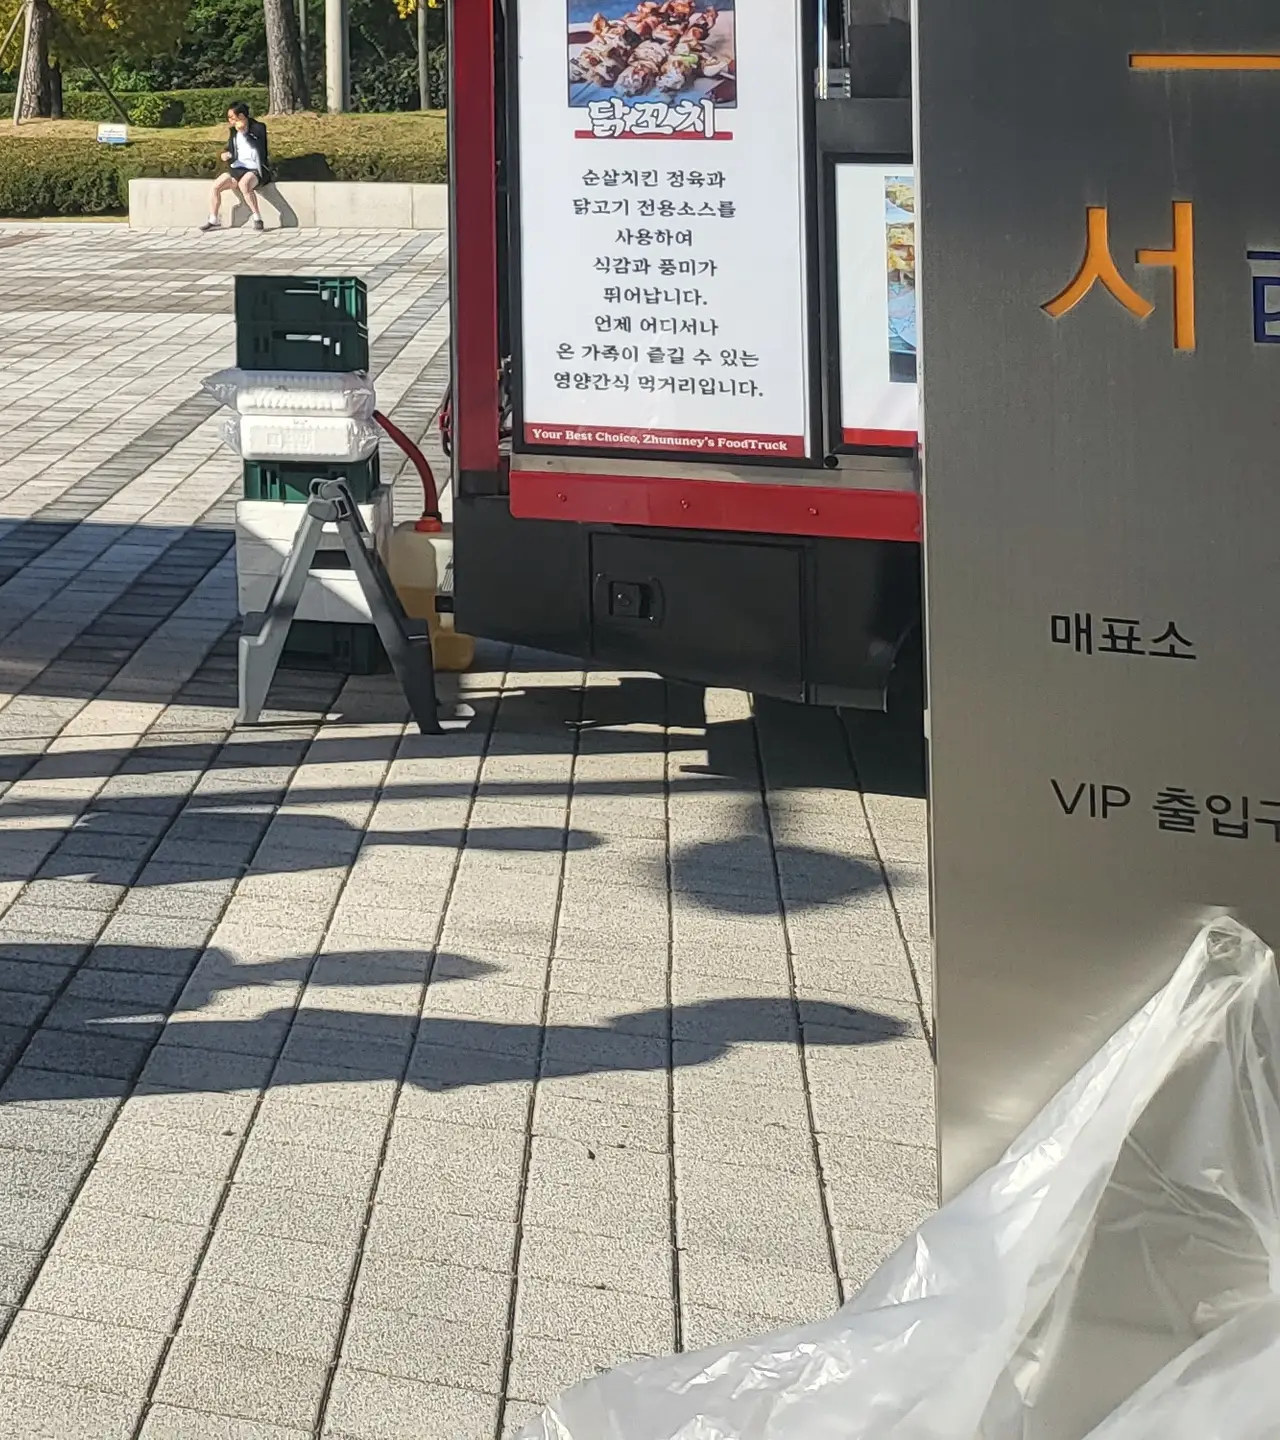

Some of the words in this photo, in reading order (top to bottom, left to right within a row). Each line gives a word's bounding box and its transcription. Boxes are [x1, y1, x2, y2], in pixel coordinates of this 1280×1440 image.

[588, 96, 716, 138] 닭꼬치
[582, 169, 658, 188] 순살치킨
[666, 170, 726, 188] 정육과
[572, 197, 630, 216] 닭고기
[637, 200, 736, 218] 전용소스를
[615, 228, 693, 247] 사용하여
[593, 256, 651, 275] 식감과
[658, 258, 717, 277] 풍미가
[1040, 200, 1196, 349] 서
[603, 286, 708, 306] 뛰어납니다.
[594, 315, 632, 333] 언제
[640, 317, 718, 336] 어디서나
[556, 342, 575, 360] 온
[581, 343, 638, 363] 가족이
[646, 346, 684, 365] 즐길
[692, 349, 712, 366] 수
[720, 349, 759, 367] 있는
[554, 372, 630, 392] 영양간식
[637, 374, 764, 397] 먹거리입니다.
[532, 428, 562, 440] Your
[566, 430, 592, 441] Best
[595, 432, 641, 444] Choice,
[642, 434, 715, 449] Zhununey's
[717, 438, 788, 451] FoodTruck
[1051, 613, 1197, 660] 매표소
[1050, 778, 1131, 819] VIP
